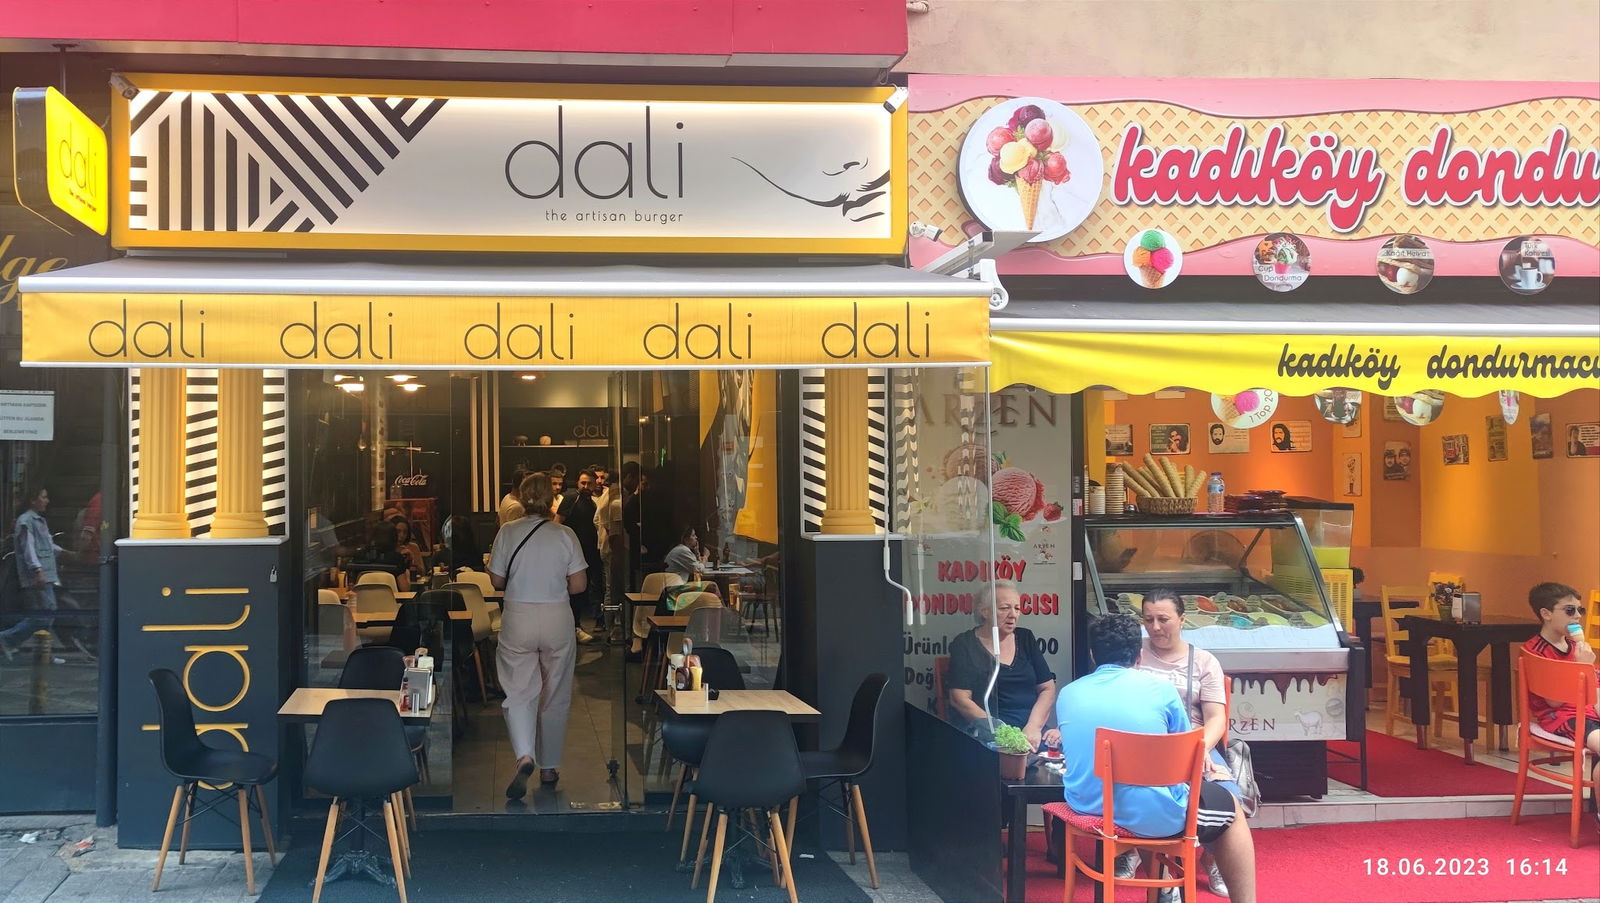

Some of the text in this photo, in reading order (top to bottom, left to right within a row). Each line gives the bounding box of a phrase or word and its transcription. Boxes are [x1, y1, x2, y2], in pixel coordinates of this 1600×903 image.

[59, 120, 97, 199] dali
[504, 105, 684, 200] dali
[1112, 123, 1600, 233] kadıköy dondu
[545, 209, 684, 225] the artisan burger
[89, 299, 205, 359] dali
[280, 301, 393, 360] dali
[464, 302, 574, 361] dali
[643, 302, 752, 360] dali
[821, 301, 930, 359] dali
[1277, 342, 1600, 391] kadıköy dondurmacı
[937, 554, 1027, 583] KADIKÖY
[903, 592, 1060, 616] DONDUCISI
[903, 631, 951, 656] Ürünl
[904, 666, 933, 690] Doğ
[1229, 718, 1275, 735] RZEN
